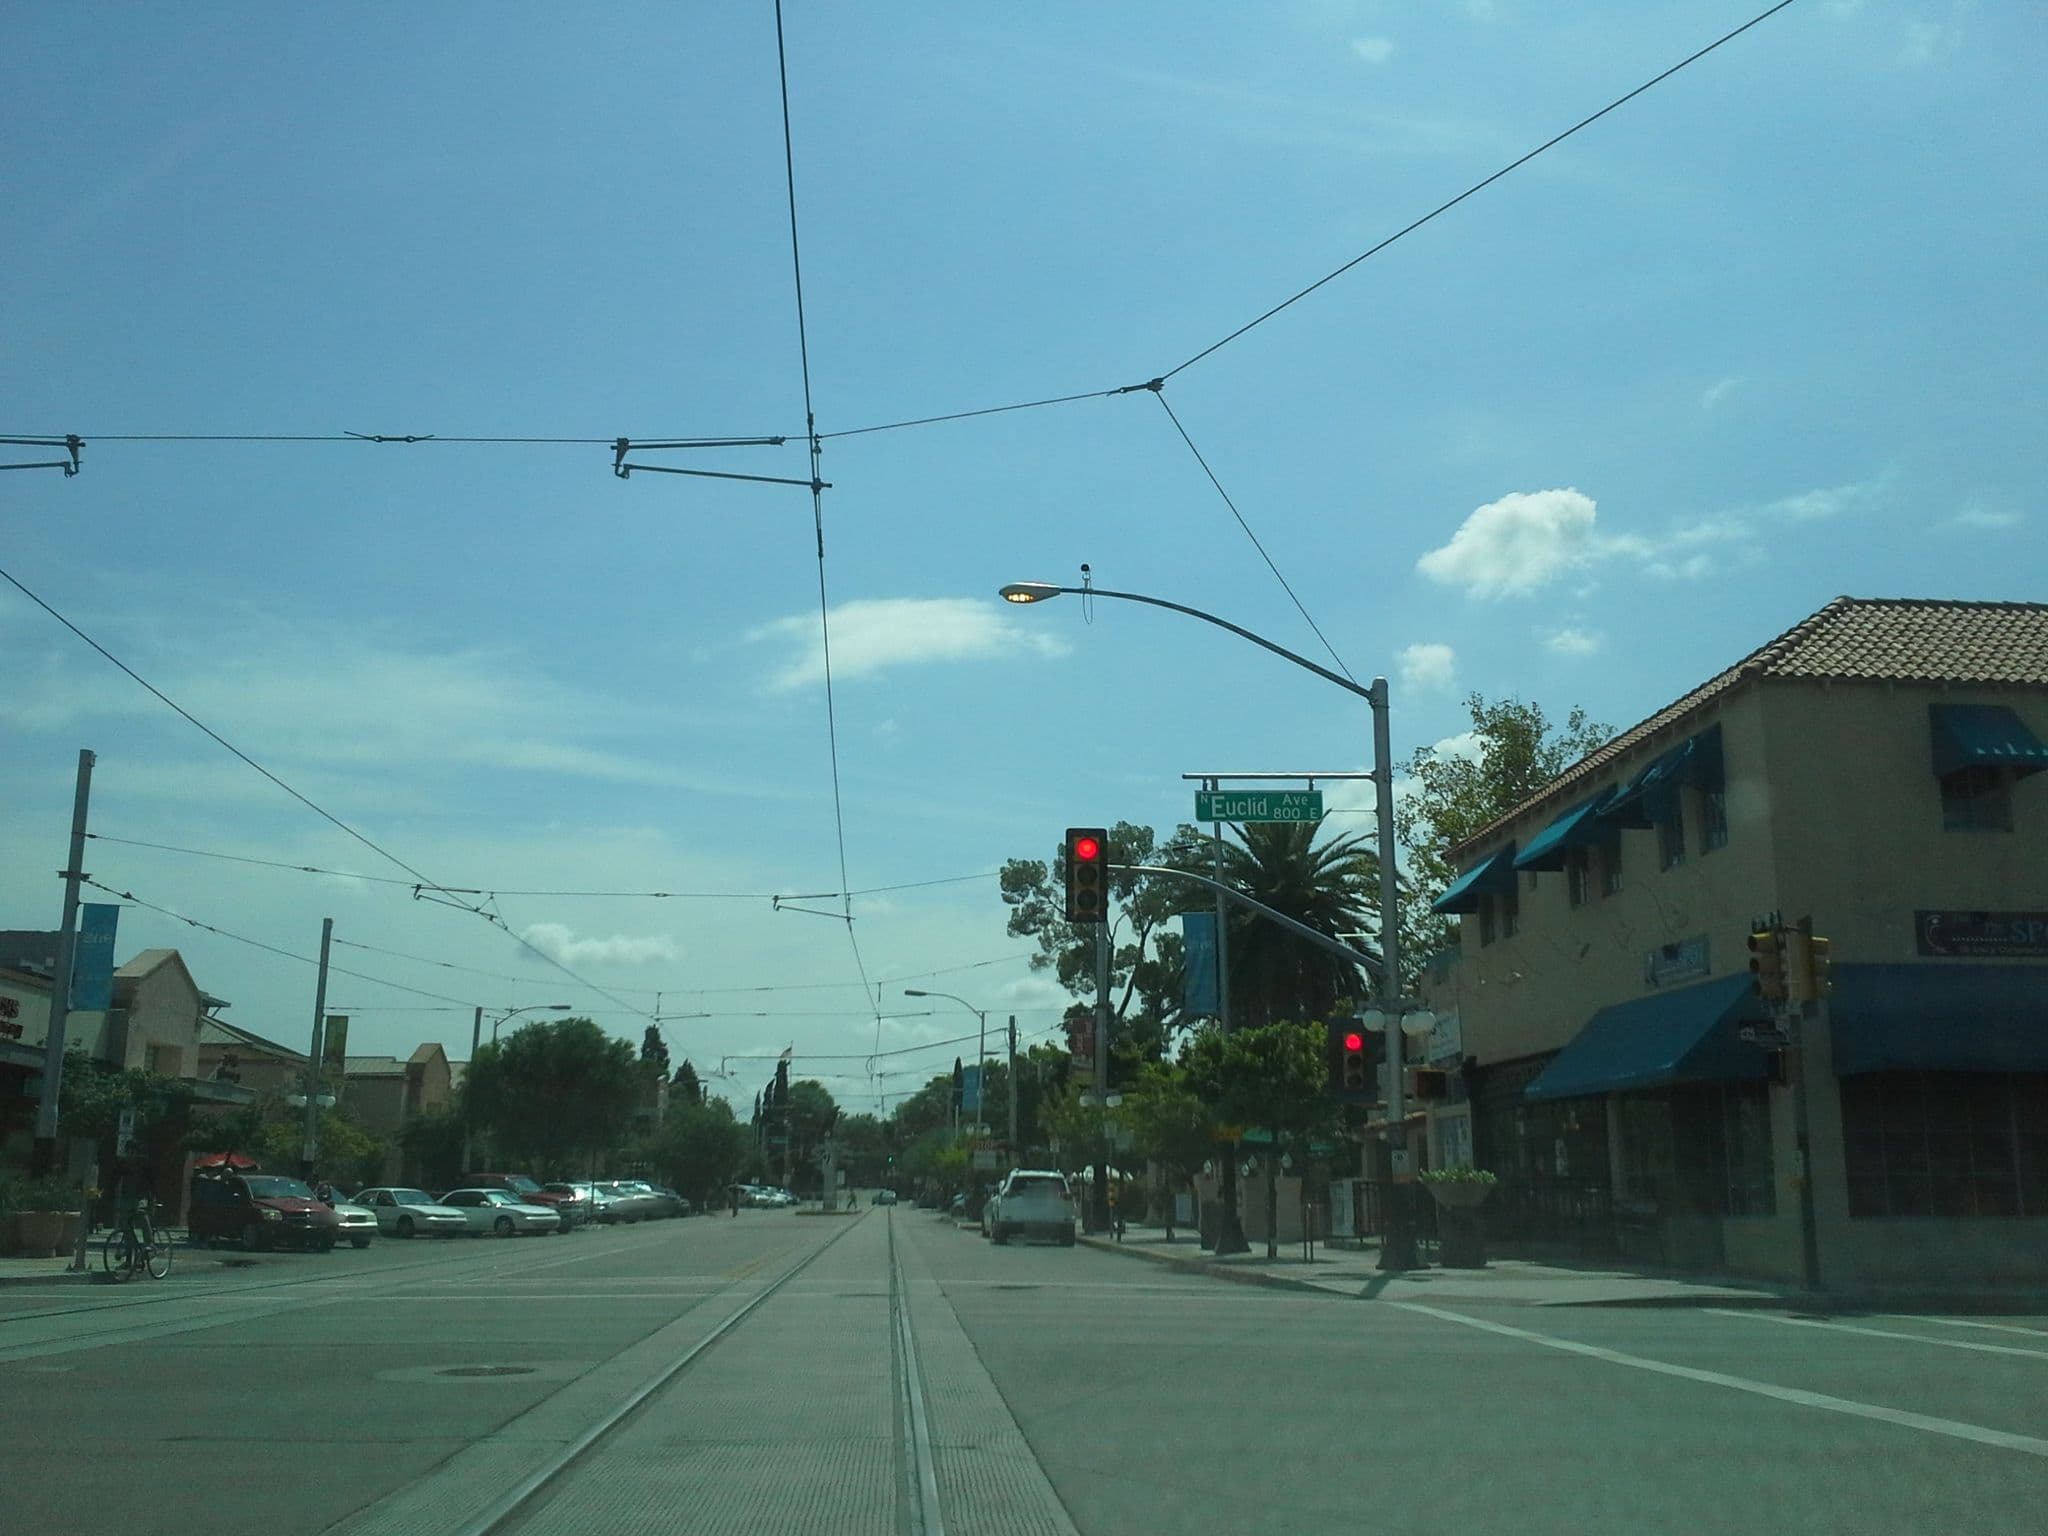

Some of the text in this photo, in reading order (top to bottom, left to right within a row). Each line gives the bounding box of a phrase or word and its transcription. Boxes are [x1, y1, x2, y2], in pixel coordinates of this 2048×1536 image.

[1200, 794, 1308, 818] N Euclid Ave
[1273, 807, 1318, 819] 800 E
